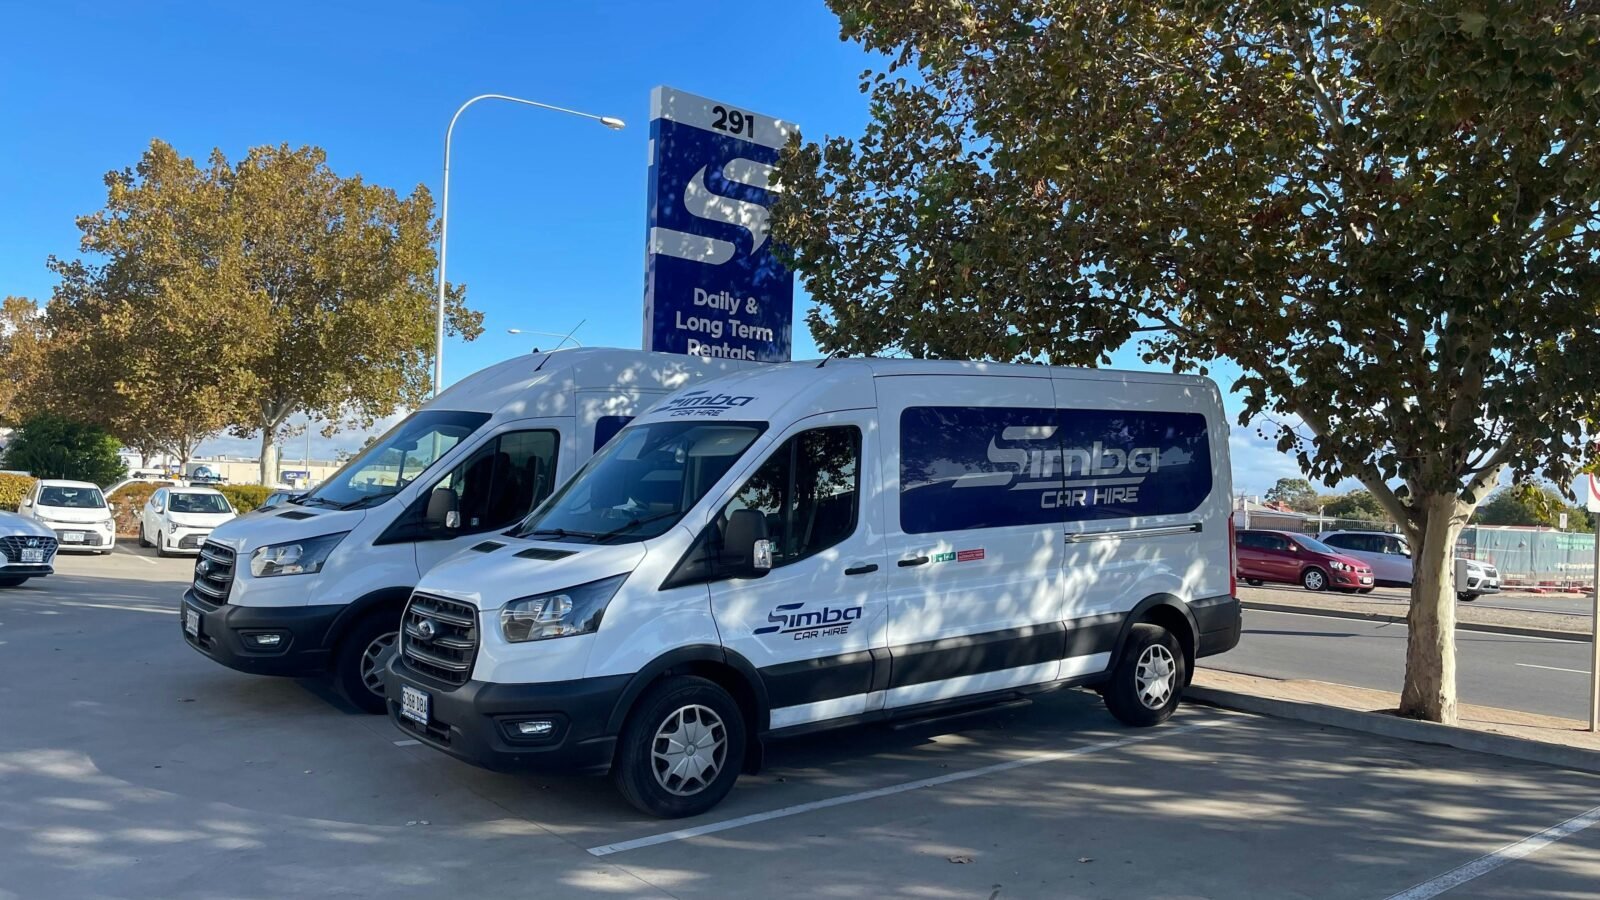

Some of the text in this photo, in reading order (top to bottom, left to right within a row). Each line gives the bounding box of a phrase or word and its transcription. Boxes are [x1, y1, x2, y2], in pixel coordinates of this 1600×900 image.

[711, 105, 754, 139] 291
[693, 287, 759, 315] Daily &
[675, 311, 774, 342] Long Term
[687, 338, 756, 361] Rentals
[650, 390, 756, 414] Simba
[670, 409, 724, 417] CAR HIRE
[951, 425, 1160, 489] Simba
[1040, 486, 1140, 509] CAR HIRE
[752, 602, 863, 635] Simba
[794, 627, 848, 640] CAR HIRE
